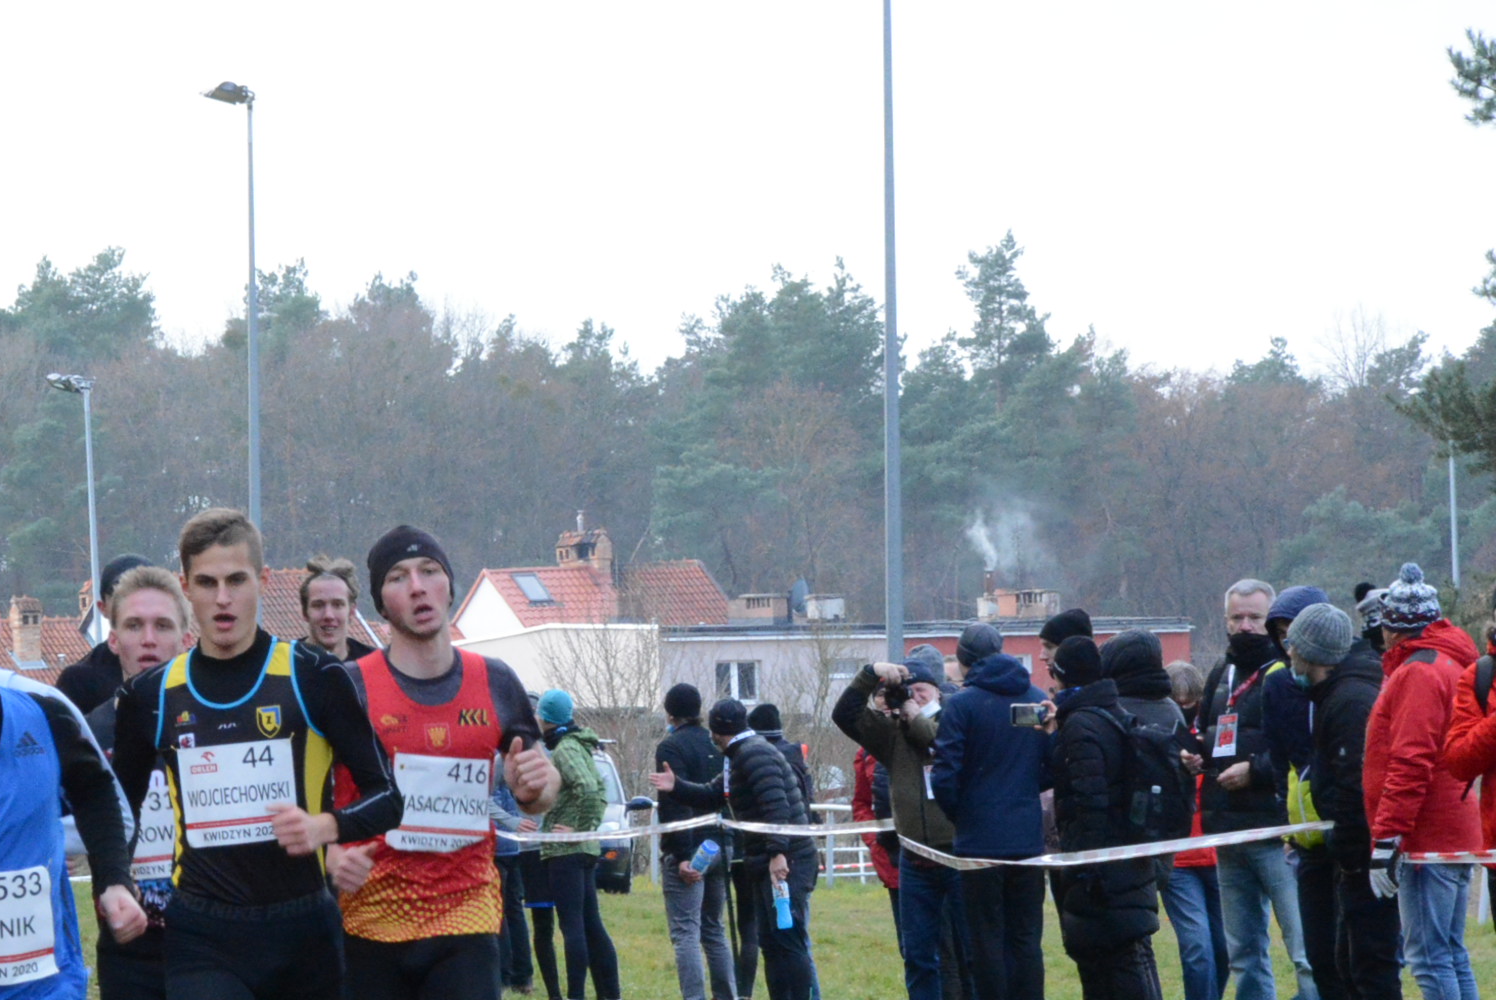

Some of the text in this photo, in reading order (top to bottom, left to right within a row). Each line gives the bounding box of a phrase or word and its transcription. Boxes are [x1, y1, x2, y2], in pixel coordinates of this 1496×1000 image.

[242, 745, 274, 768] 44
[447, 762, 487, 784] 416
[187, 781, 290, 808] WOJCIECHOWSKI
[403, 794, 489, 817] ASACZYŃSKI
[203, 825, 274, 842] KWIDZYN 202
[400, 834, 447, 848] KWIDZYN
[12, 962, 38, 976] 2020
